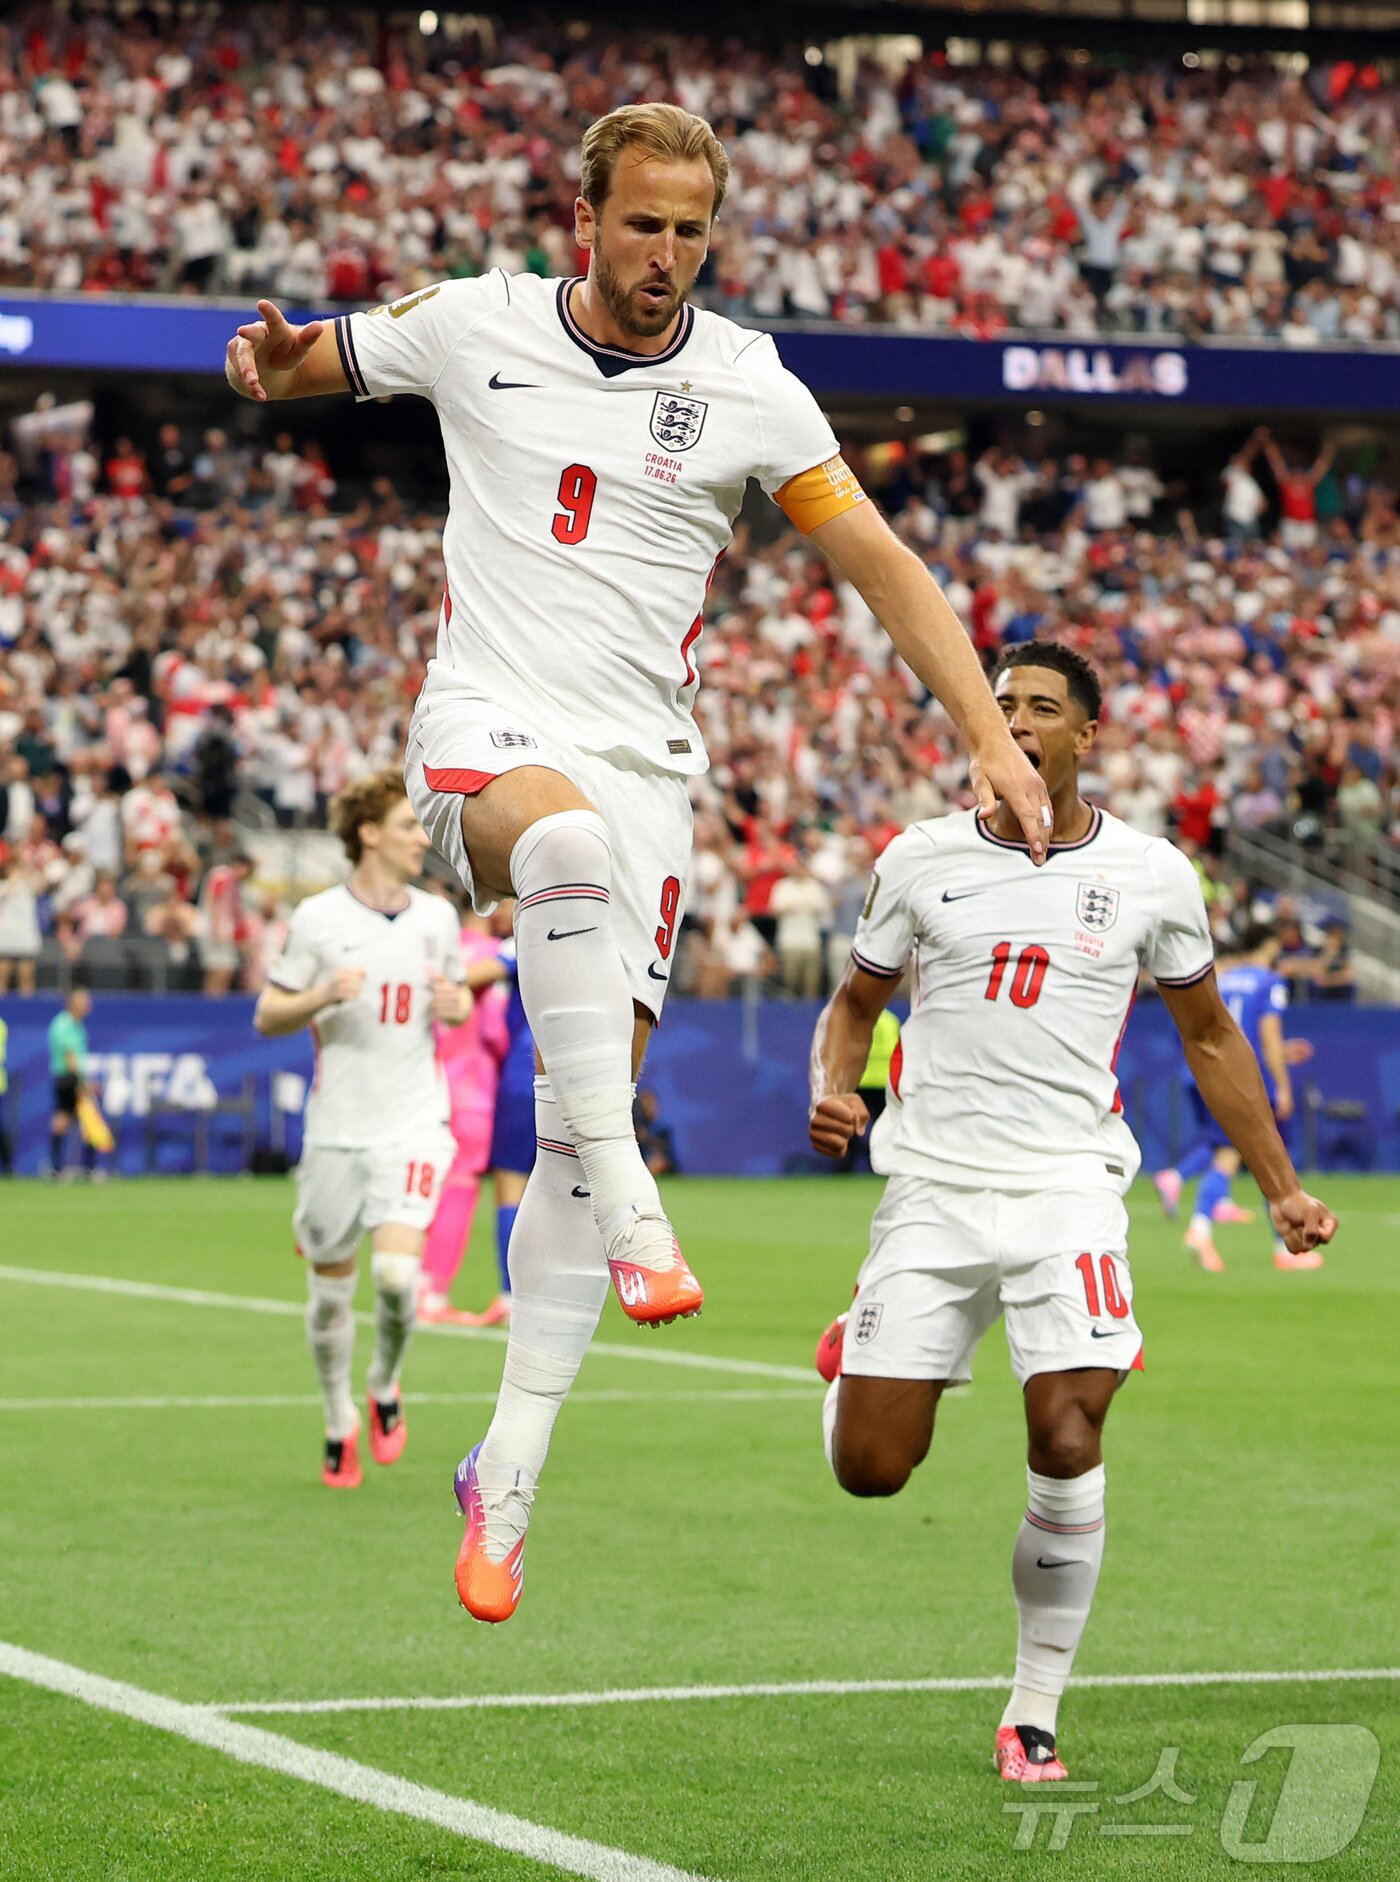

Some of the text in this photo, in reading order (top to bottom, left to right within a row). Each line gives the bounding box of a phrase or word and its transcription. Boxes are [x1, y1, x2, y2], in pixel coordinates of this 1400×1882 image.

[1002, 346, 1188, 396] DALLAS
[644, 465, 677, 484] 17.06.26
[645, 452, 682, 472] CROATIA
[551, 463, 597, 545] 9
[654, 875, 680, 960] 9
[985, 941, 1050, 1009] 10
[380, 982, 411, 1025] 18
[406, 1160, 434, 1199] 18
[1075, 1252, 1129, 1319] 10
